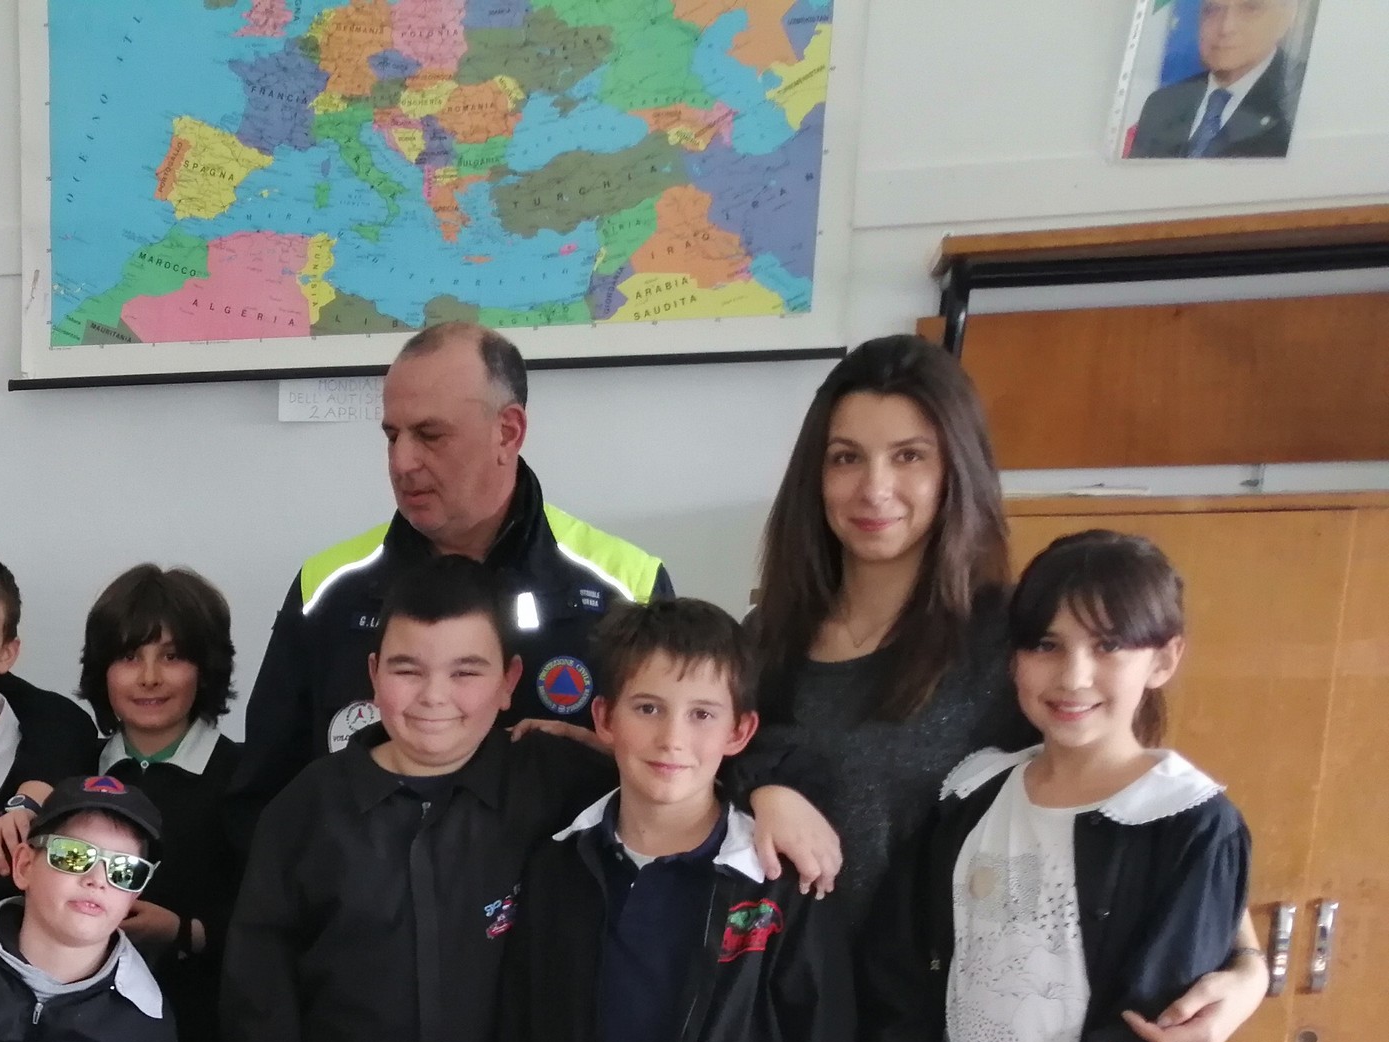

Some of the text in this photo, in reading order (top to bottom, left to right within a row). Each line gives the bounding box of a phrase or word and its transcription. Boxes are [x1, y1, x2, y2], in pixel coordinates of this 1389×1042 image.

[335, 24, 384, 35] GERMANIA
[401, 28, 459, 38] POLONIA
[251, 86, 308, 105] FRANCIA
[447, 102, 495, 113] ROMANIA
[158, 142, 183, 192] PORTOGALLO
[183, 159, 236, 183] SPAGNA
[458, 156, 500, 167] BULGARIA
[514, 165, 658, 208] TURCHIA
[602, 219, 642, 236] SIRIA
[651, 232, 710, 260] IRAQ
[138, 252, 197, 277] MAROCCO
[312, 245, 322, 307] TUNISIA
[635, 277, 689, 300] ARABIA
[192, 299, 295, 327] ALGERIA
[633, 295, 697, 321] SAUDITA
[90, 323, 133, 343] MAURITANIA
[318, 378, 381, 392] MONDIAL
[309, 405, 381, 420] 2 APRILE
